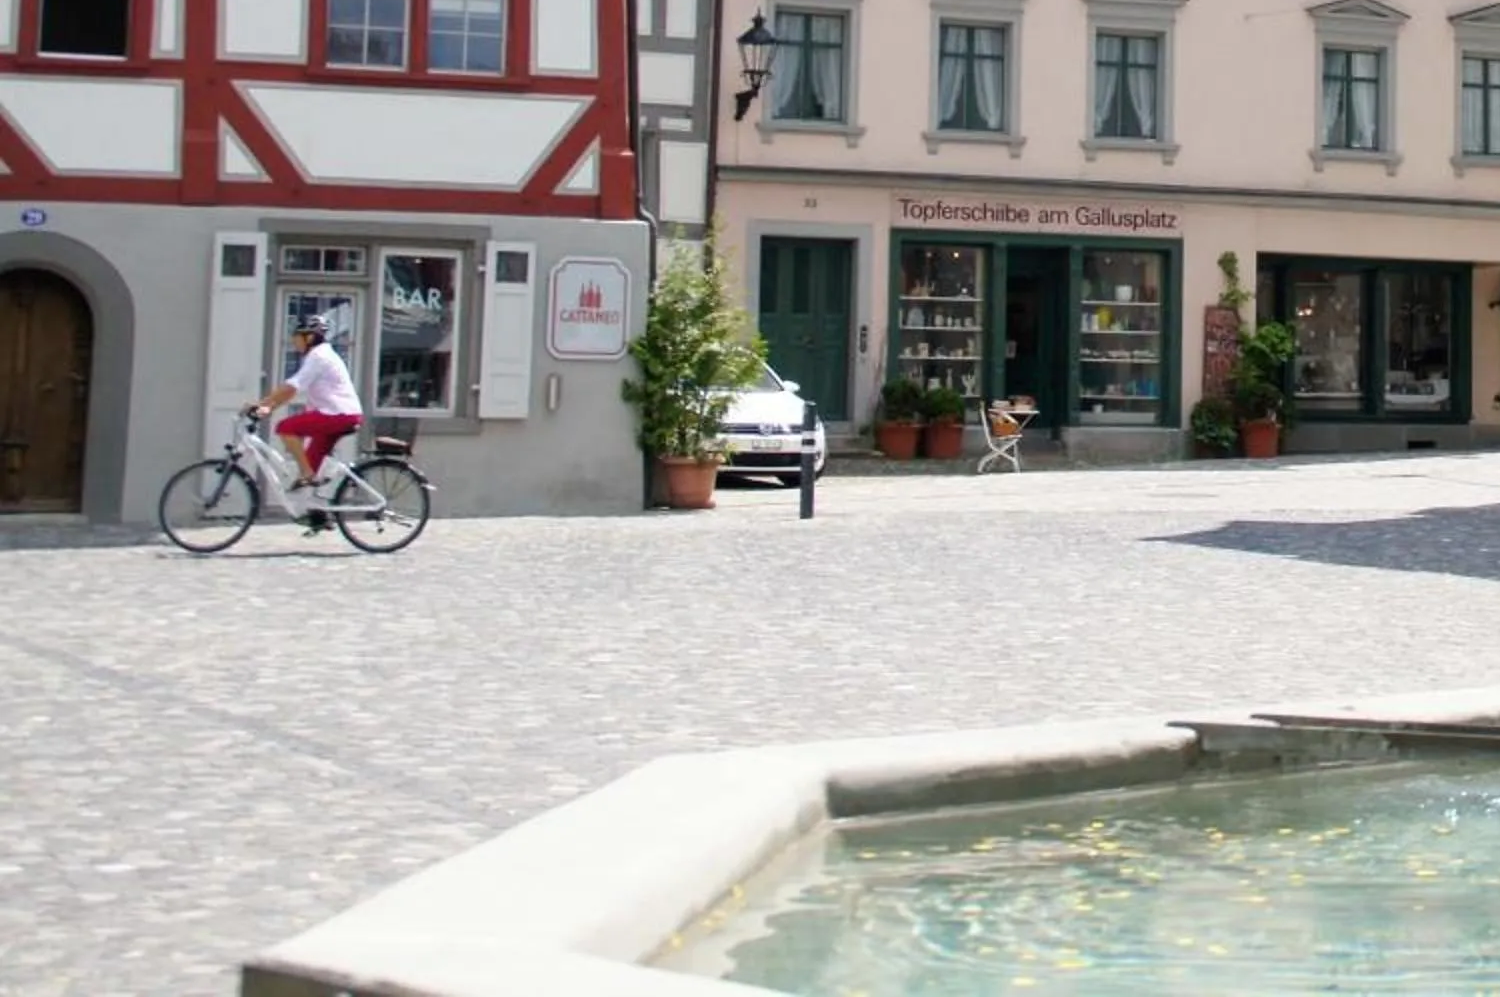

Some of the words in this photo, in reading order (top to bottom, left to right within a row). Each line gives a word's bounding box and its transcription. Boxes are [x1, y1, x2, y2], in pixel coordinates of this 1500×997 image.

[1038, 209, 1069, 225] am
[1075, 206, 1178, 231] Gallusplatz
[393, 287, 442, 310] BAR
